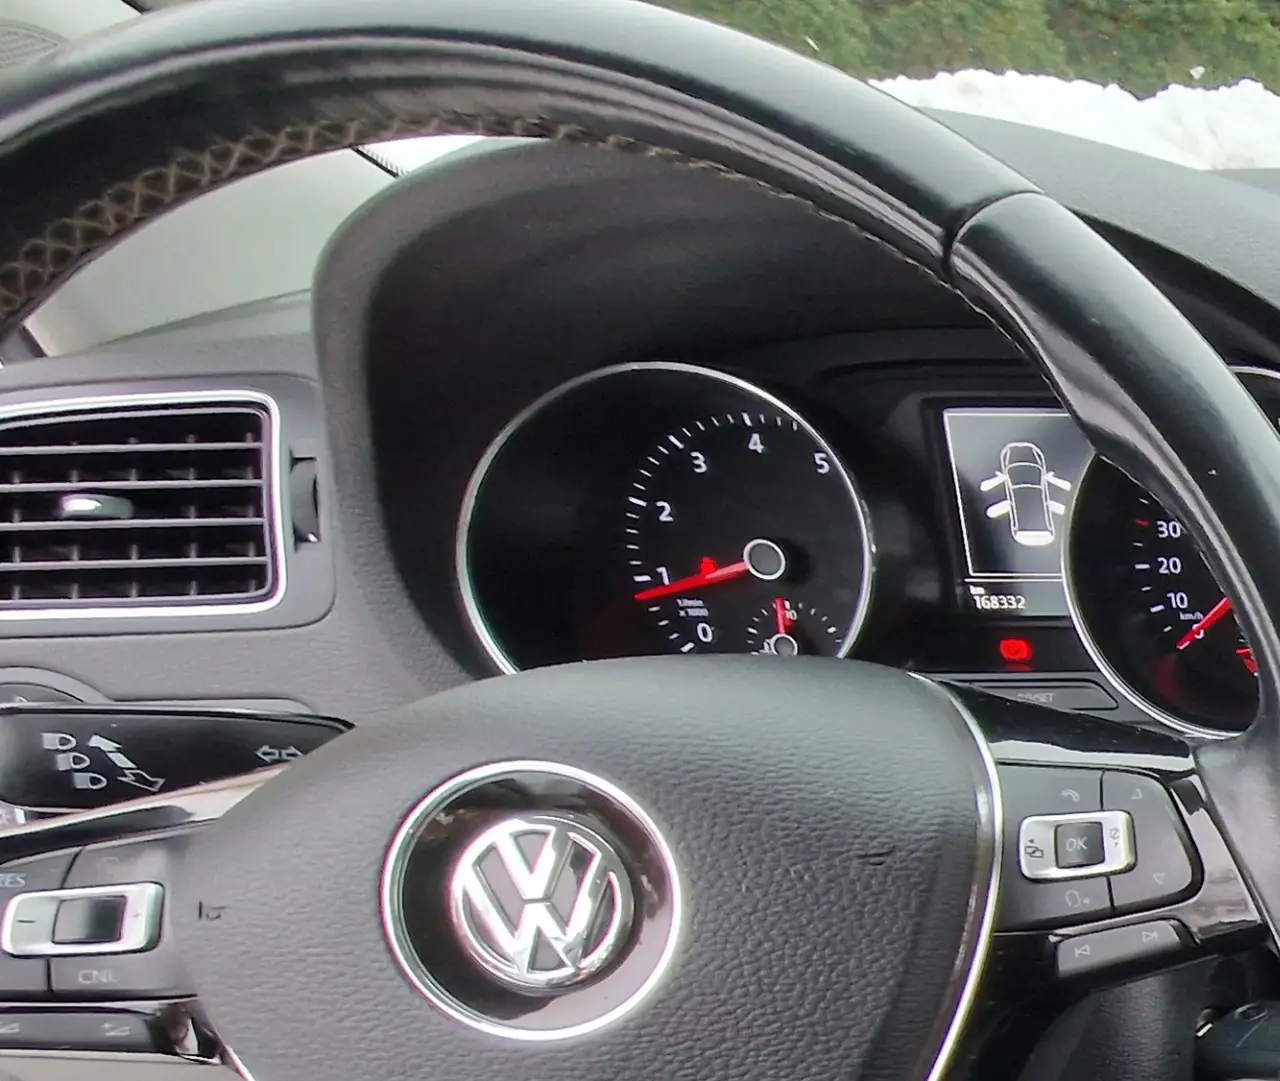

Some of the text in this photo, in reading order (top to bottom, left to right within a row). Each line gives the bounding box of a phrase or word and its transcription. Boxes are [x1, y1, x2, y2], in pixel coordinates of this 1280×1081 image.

[748, 433, 764, 454] 4
[691, 452, 708, 473] 3
[814, 453, 830, 473] 5
[657, 502, 674, 522] 2
[1157, 520, 1181, 538] 30
[1157, 557, 1181, 574] 20
[656, 567, 670, 586] 1
[974, 595, 1026, 609] 168332
[1167, 592, 1188, 609] 10
[1180, 612, 1204, 620] km/h
[697, 622, 713, 643] 0
[1066, 837, 1088, 852] OK
[79, 969, 118, 984] CNL
